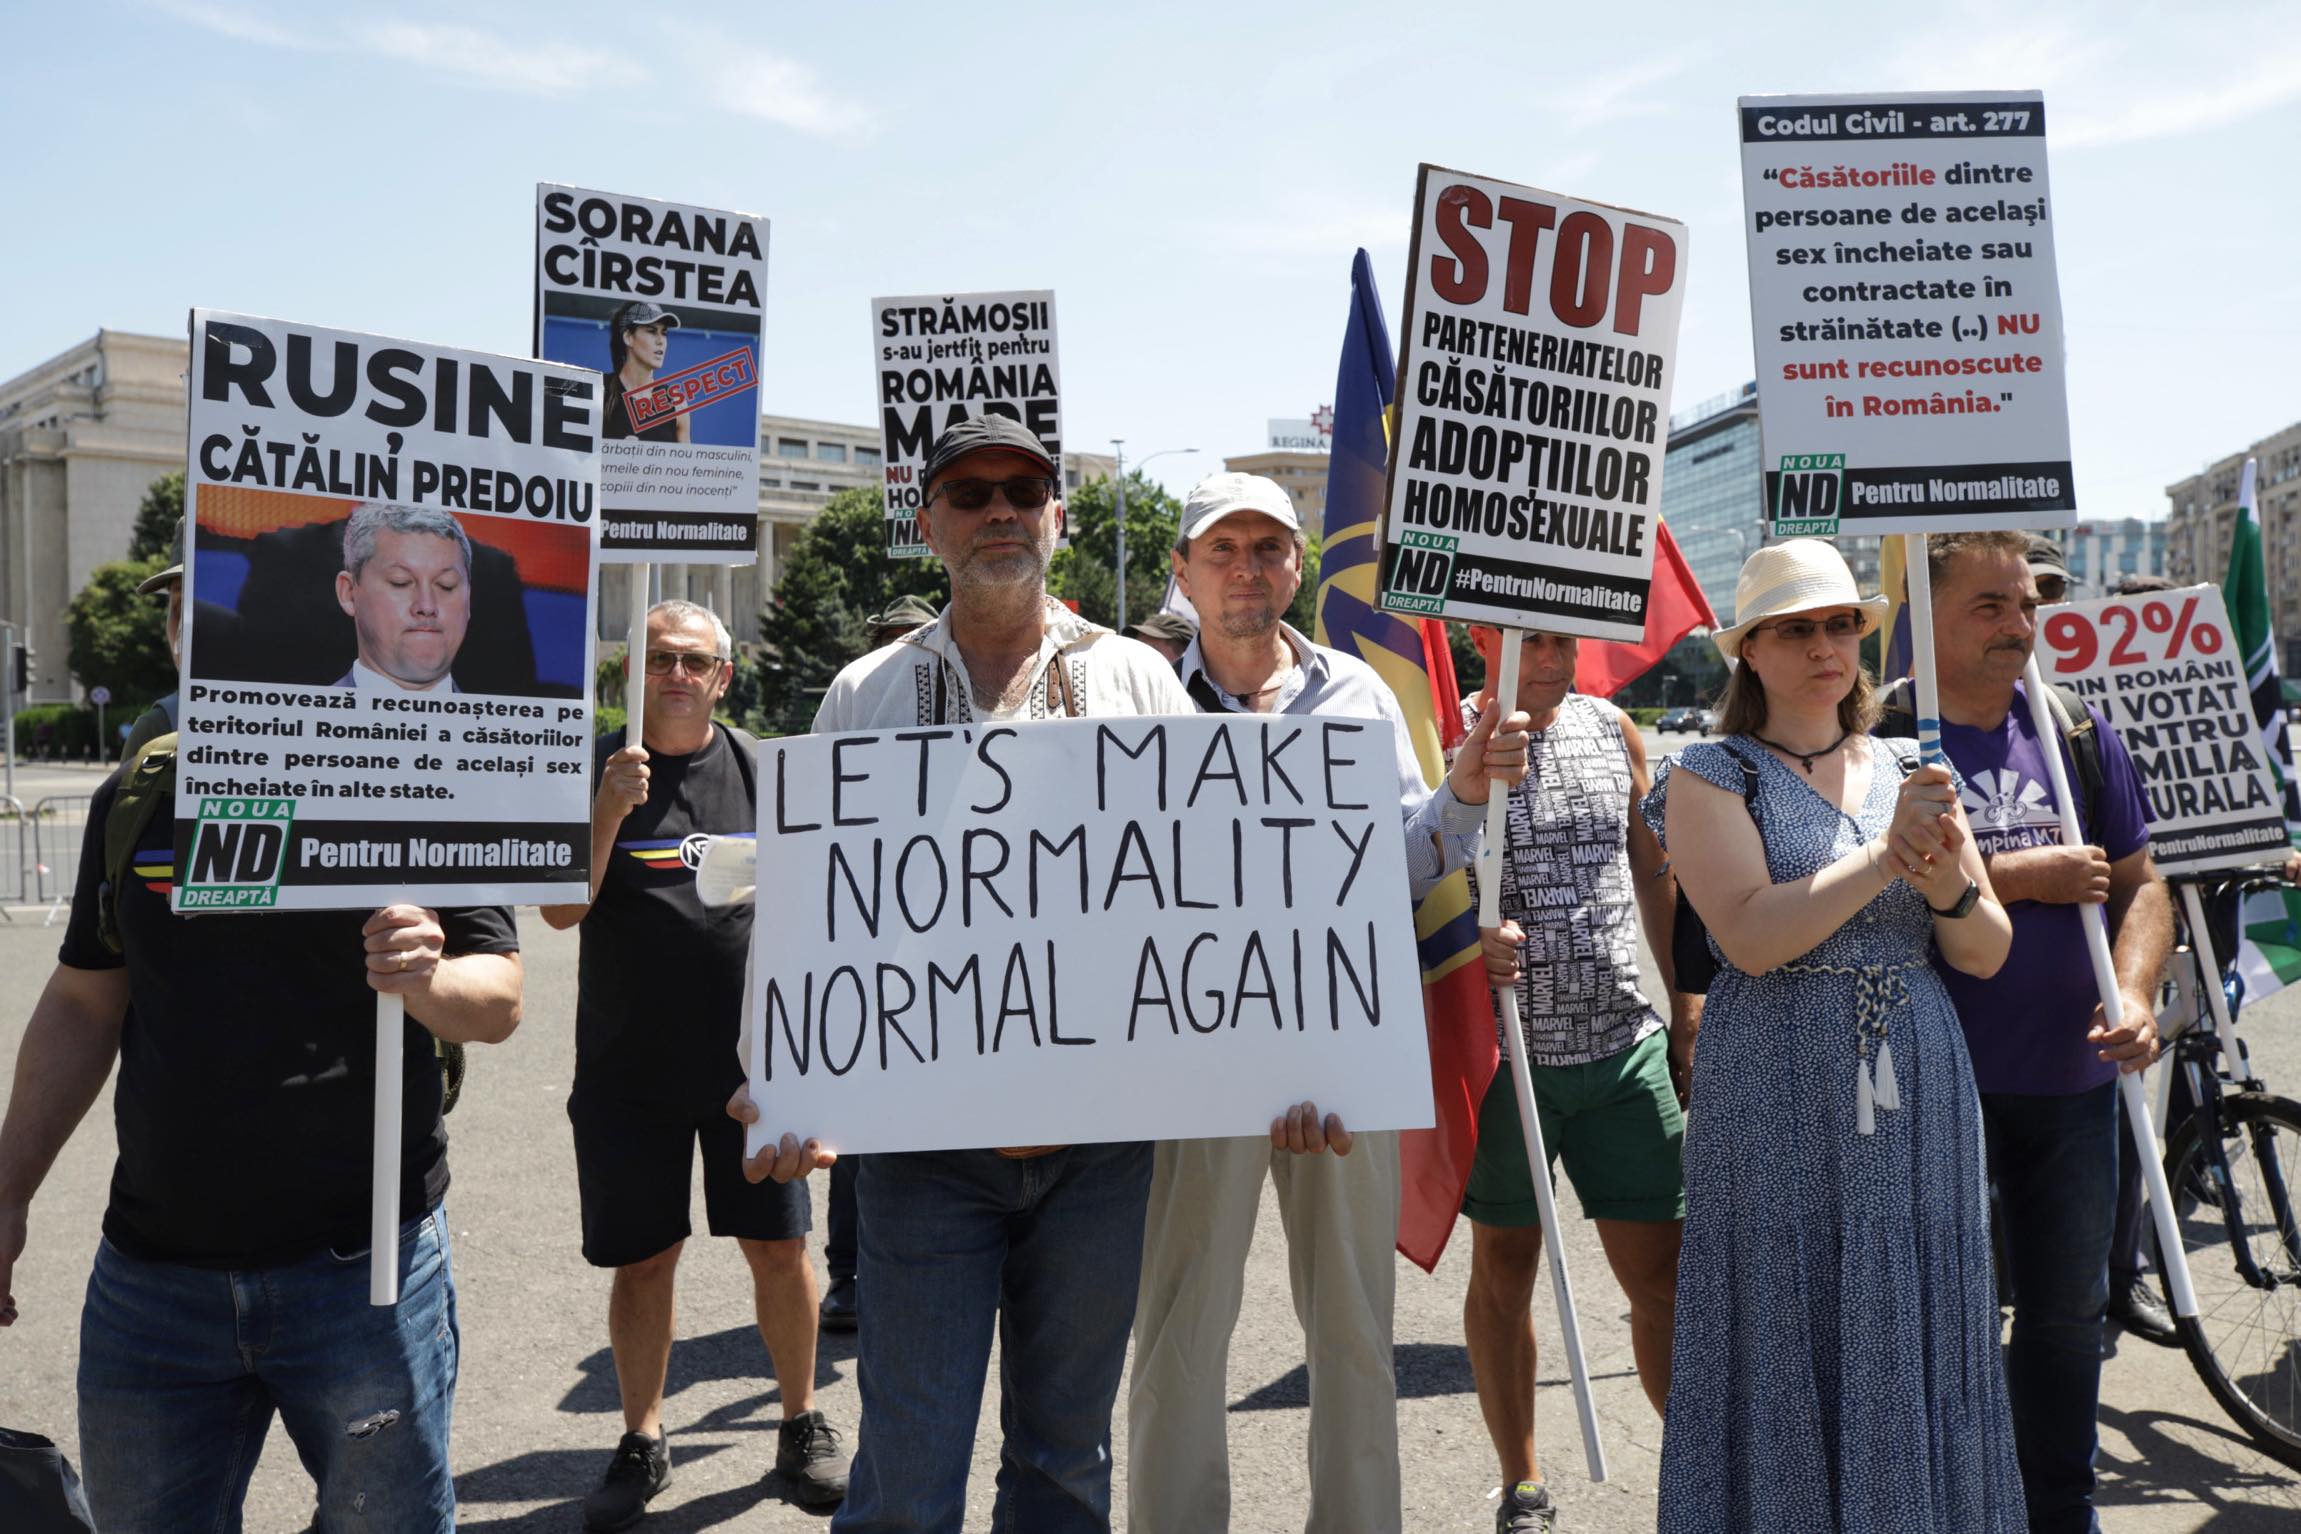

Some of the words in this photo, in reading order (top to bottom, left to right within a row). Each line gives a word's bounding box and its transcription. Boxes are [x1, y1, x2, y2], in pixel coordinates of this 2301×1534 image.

[1757, 114, 1838, 136] Codul
[1845, 111, 1905, 134] Civil
[1930, 113, 1976, 133] art.
[1982, 111, 2030, 132] 277
[1945, 161, 2033, 185] dintre
[544, 192, 762, 260] SORANA
[1755, 207, 1892, 233] persoane
[1901, 202, 1937, 224] de
[1430, 184, 1677, 337] STOP
[1776, 247, 1827, 265] sex
[1834, 239, 1972, 263] încheiate
[1981, 241, 2033, 260] sau
[544, 237, 761, 308] CÎRSTEA
[1802, 279, 1976, 302] contractate
[1983, 275, 2013, 297] în
[1780, 317, 1942, 342] străinătate
[1997, 314, 2040, 336] NU
[883, 344, 922, 360] s-au
[927, 337, 982, 363] jertfit
[988, 338, 1050, 361] pentru
[1422, 311, 1664, 390] PARTENERIATELOR
[882, 357, 1057, 404] ROMÂNIA
[1783, 357, 1850, 380] sunt
[1858, 353, 2043, 378] recunoscute
[633, 359, 746, 421] RESPECT
[1417, 356, 1658, 444] CĂSĂTORIILOR
[1825, 395, 1854, 418] în
[648, 445, 666, 457] din
[669, 449, 692, 458] nou
[1271, 436, 1326, 448] REGINA
[200, 424, 399, 500] CĂTĂLIN
[412, 460, 593, 522] PREDOIU
[643, 464, 663, 476] din
[666, 467, 689, 477] nou
[692, 467, 744, 480] feminine,
[886, 466, 912, 484] NU
[1783, 456, 1842, 469] NOUA
[636, 482, 655, 493] din
[659, 485, 683, 495] nou
[1781, 473, 1838, 517] ND
[1852, 481, 1924, 505] Pentru
[1929, 476, 2060, 503] Normalitate
[600, 519, 653, 539] Pentru
[657, 520, 747, 541] Normalitate
[1402, 479, 1645, 558] HOMOSEXUALE
[1404, 532, 1456, 551] NOUA
[1393, 549, 1450, 595] ND
[1455, 568, 1642, 613] #PentruNormalitate
[2044, 596, 2222, 673] 92%
[2115, 660, 2235, 691] ROMÂNI
[190, 685, 356, 709] Promovează
[558, 705, 584, 722] pe
[2120, 682, 2238, 722] VOTAT
[188, 716, 303, 737] teritoriul
[316, 721, 427, 741] României
[438, 729, 450, 743] a
[463, 726, 583, 747] căsătoriilor
[2117, 713, 2249, 750] NTRU
[187, 746, 269, 766] dintre
[285, 752, 400, 770] persoane
[414, 753, 443, 770] de
[546, 760, 582, 775] sex
[2132, 741, 2261, 784] MILIA
[186, 776, 307, 796] încheiate
[312, 779, 334, 797] în
[339, 781, 385, 798] alte
[390, 782, 455, 799] state.
[776, 727, 1018, 834] LET'S
[1097, 722, 1369, 811] MAKE
[203, 800, 290, 817] NOUA
[191, 823, 283, 883] ND
[301, 837, 401, 868] Pentru
[408, 838, 572, 868] Normalitate
[1513, 846, 1555, 863] MARVEL
[2149, 826, 2284, 857] PentruNormalitate
[827, 817, 1375, 942] NORMALITY
[183, 887, 272, 905] DREAPTĂ
[765, 938, 1096, 1081] NORMAL
[1127, 921, 1381, 1042] AGAIN
[1532, 1016, 1575, 1032] MARVEL
